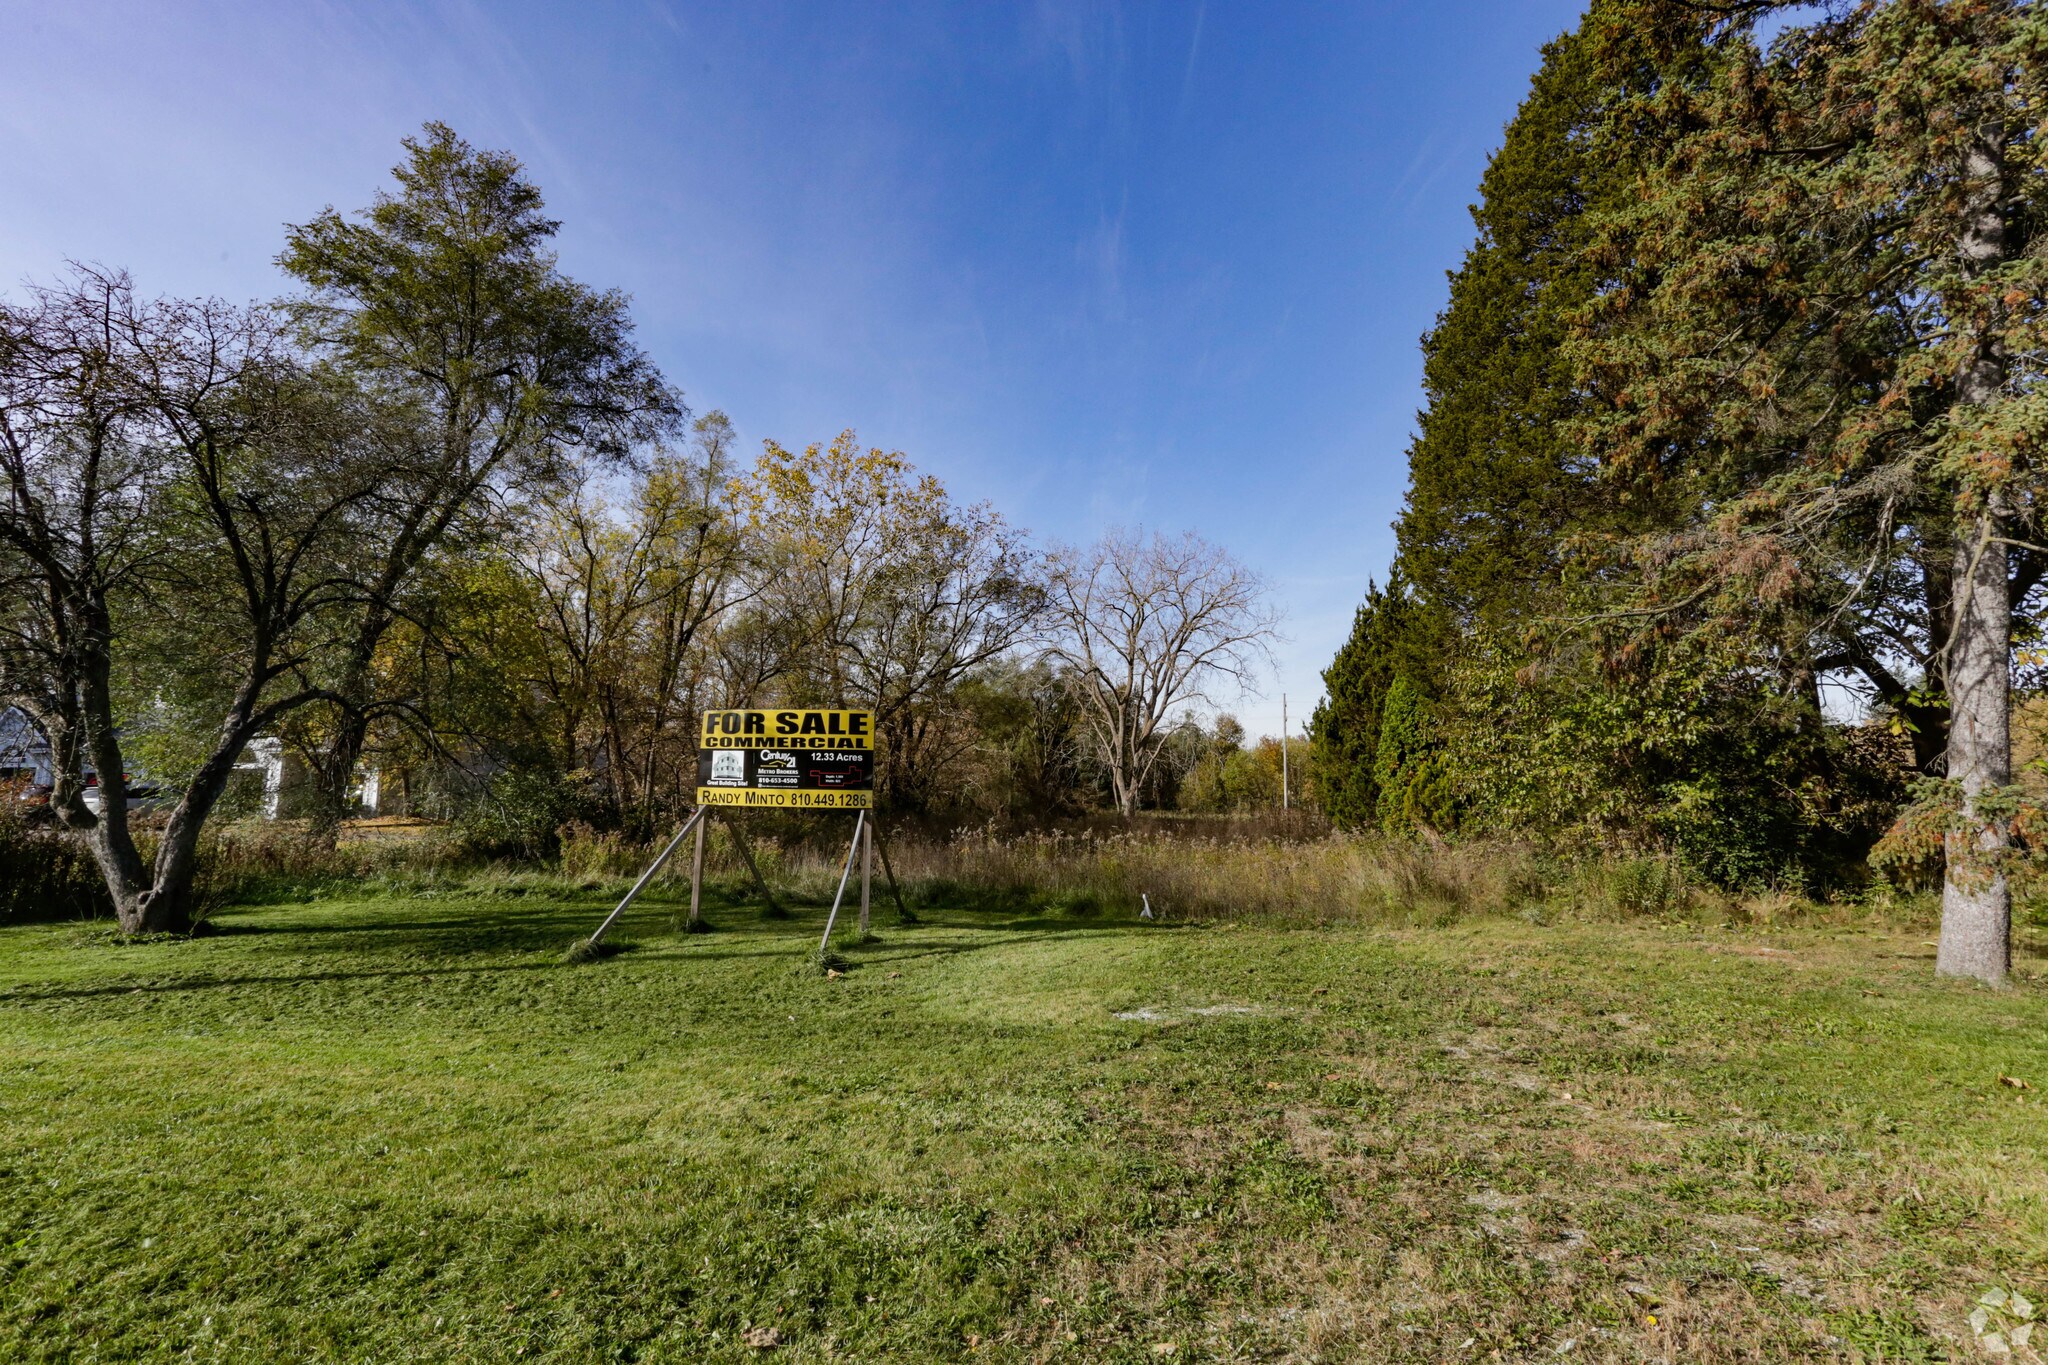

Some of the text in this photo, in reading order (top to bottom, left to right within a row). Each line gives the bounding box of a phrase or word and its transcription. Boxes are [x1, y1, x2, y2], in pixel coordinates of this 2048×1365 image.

[706, 712, 869, 735] FOR SALE
[705, 736, 868, 749] COMMERCIAL
[760, 749, 790, 762] Century
[786, 756, 797, 768] 21
[811, 752, 863, 762] 12.33 Acres
[702, 790, 867, 807] RANDY MINTO 810.449.1286
